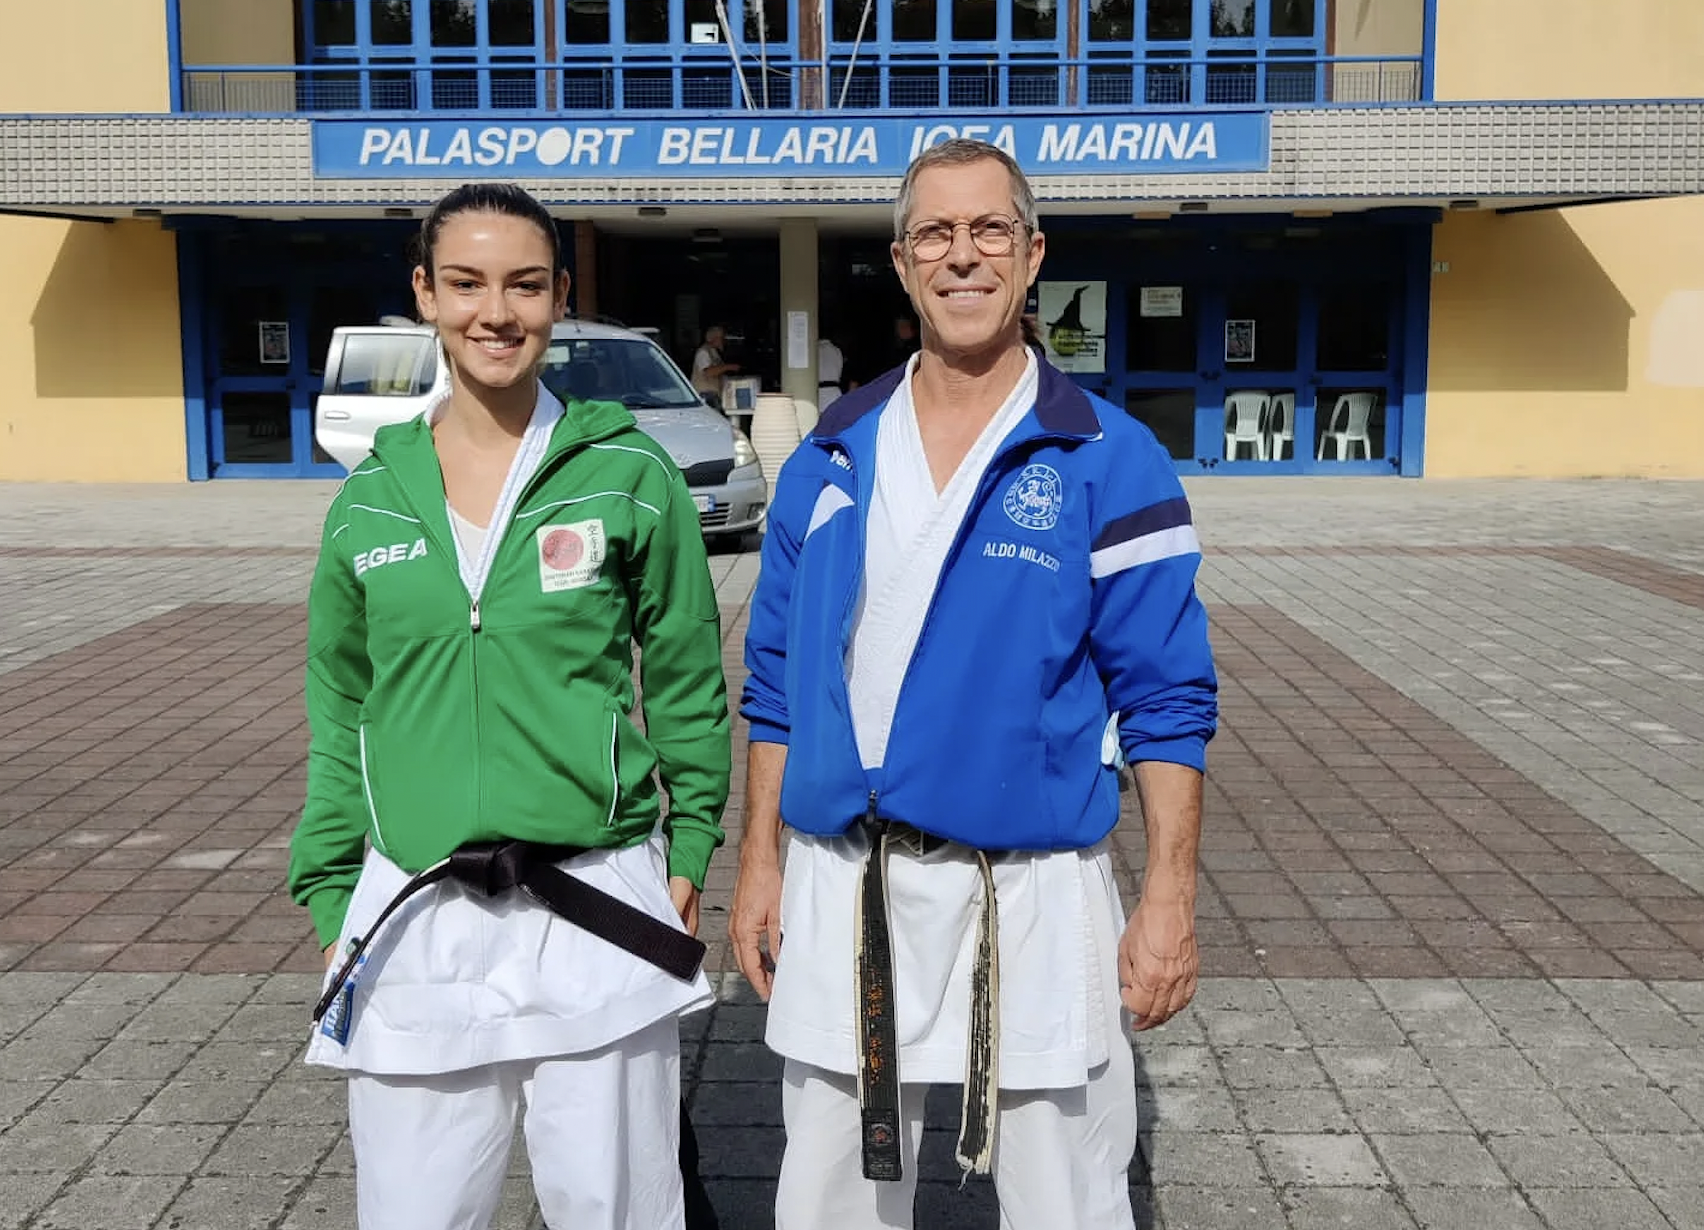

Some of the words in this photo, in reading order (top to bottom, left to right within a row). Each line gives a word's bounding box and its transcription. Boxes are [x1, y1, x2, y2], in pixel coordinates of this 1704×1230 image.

[358, 127, 635, 165] PALASPORT
[657, 127, 879, 164] BELLARIA
[1036, 121, 1218, 161] MARINA
[353, 537, 428, 577] EGEA
[982, 541, 1017, 558] ALDO
